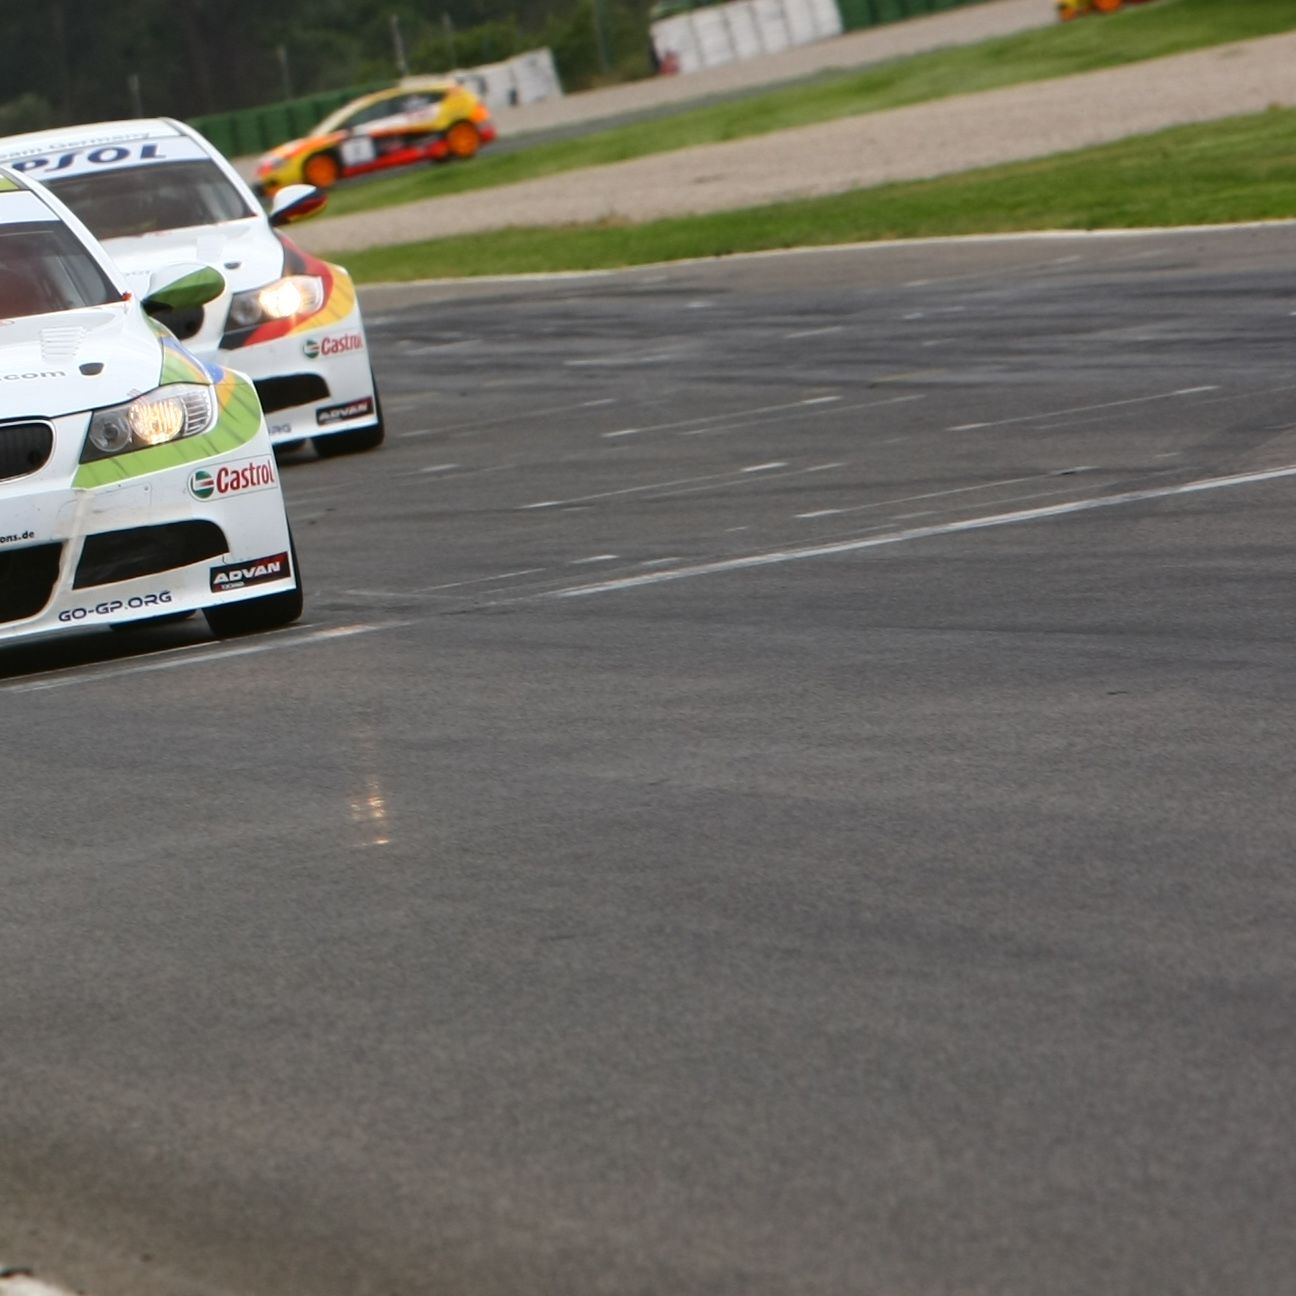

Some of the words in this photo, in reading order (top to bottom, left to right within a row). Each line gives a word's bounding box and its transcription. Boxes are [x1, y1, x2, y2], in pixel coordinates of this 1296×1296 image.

[11, 144, 167, 174] PSOL
[319, 404, 370, 420] ADVAN
[216, 459, 276, 495] Castrol
[212, 561, 281, 585] ADVAN
[58, 590, 173, 623] GO-GP.ORG
